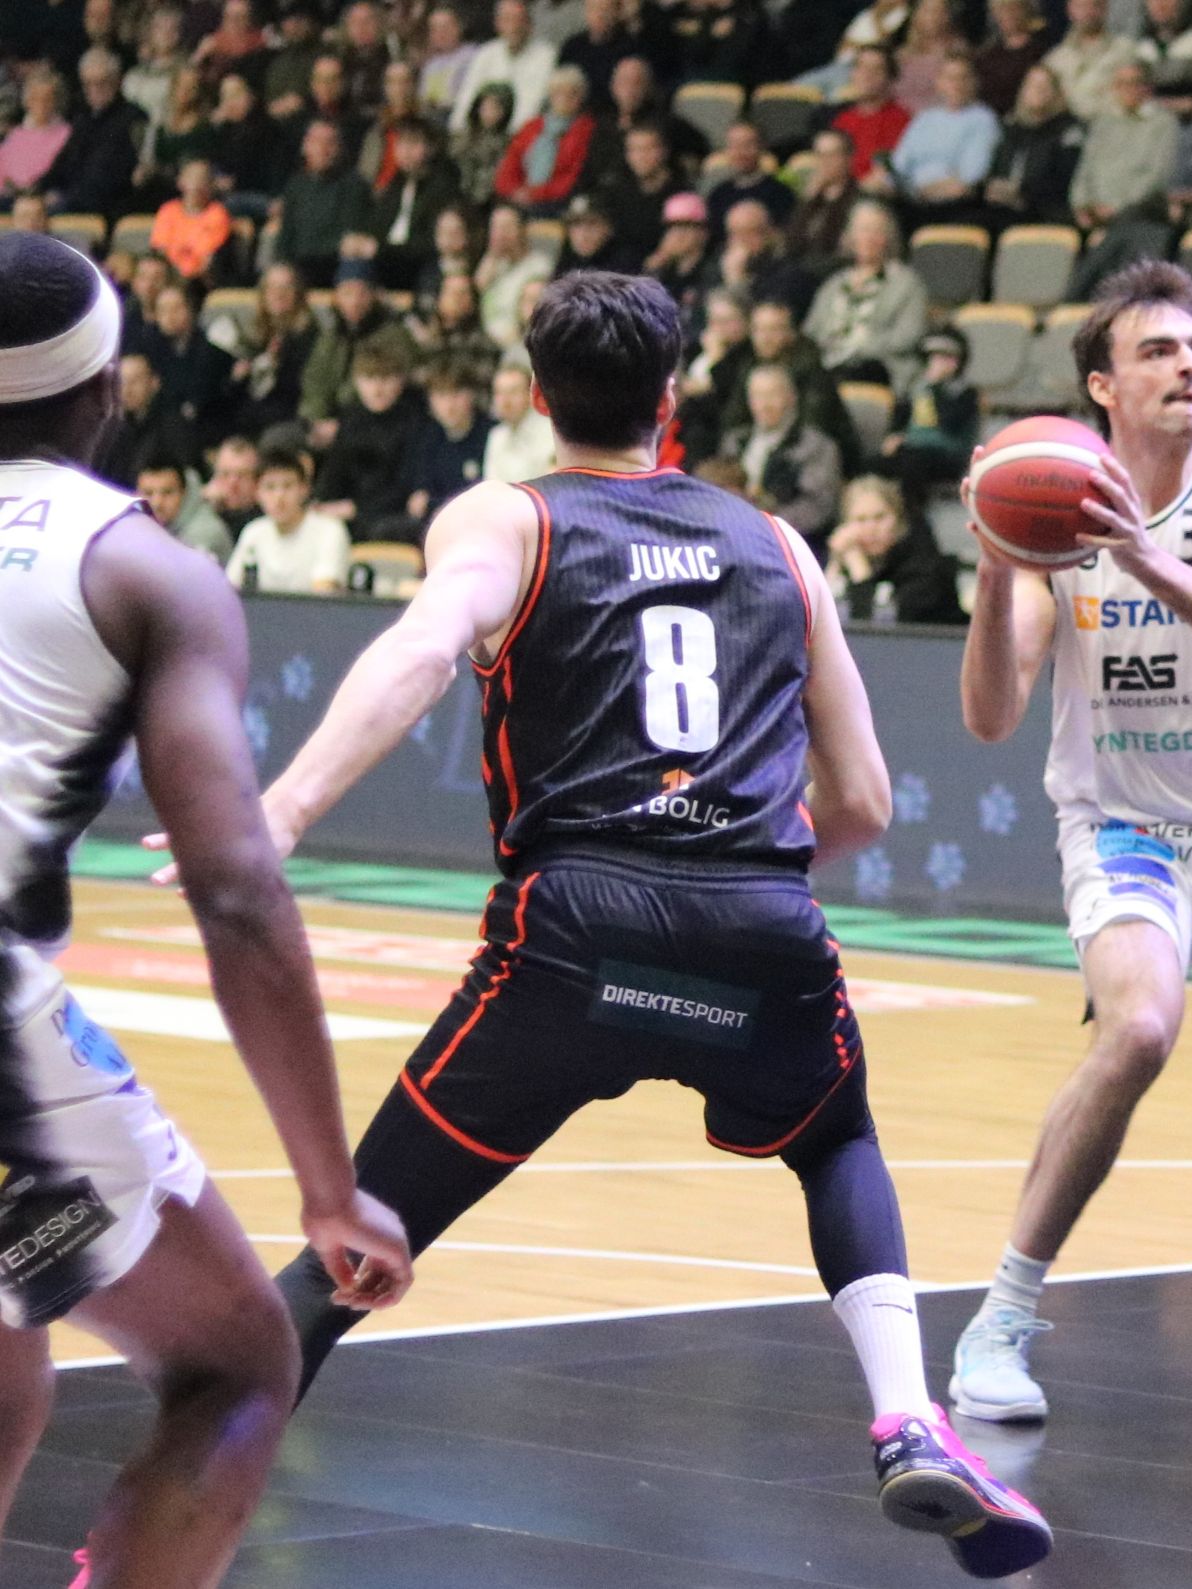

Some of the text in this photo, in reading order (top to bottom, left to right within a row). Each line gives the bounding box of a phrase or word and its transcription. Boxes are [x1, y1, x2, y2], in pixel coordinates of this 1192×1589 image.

[629, 543, 721, 582] JUKIC
[641, 605, 720, 754] 8
[1108, 695, 1178, 708] ANDERSEN
[1182, 694, 1191, 705] &
[602, 984, 749, 1029] DIREKTESPORT
